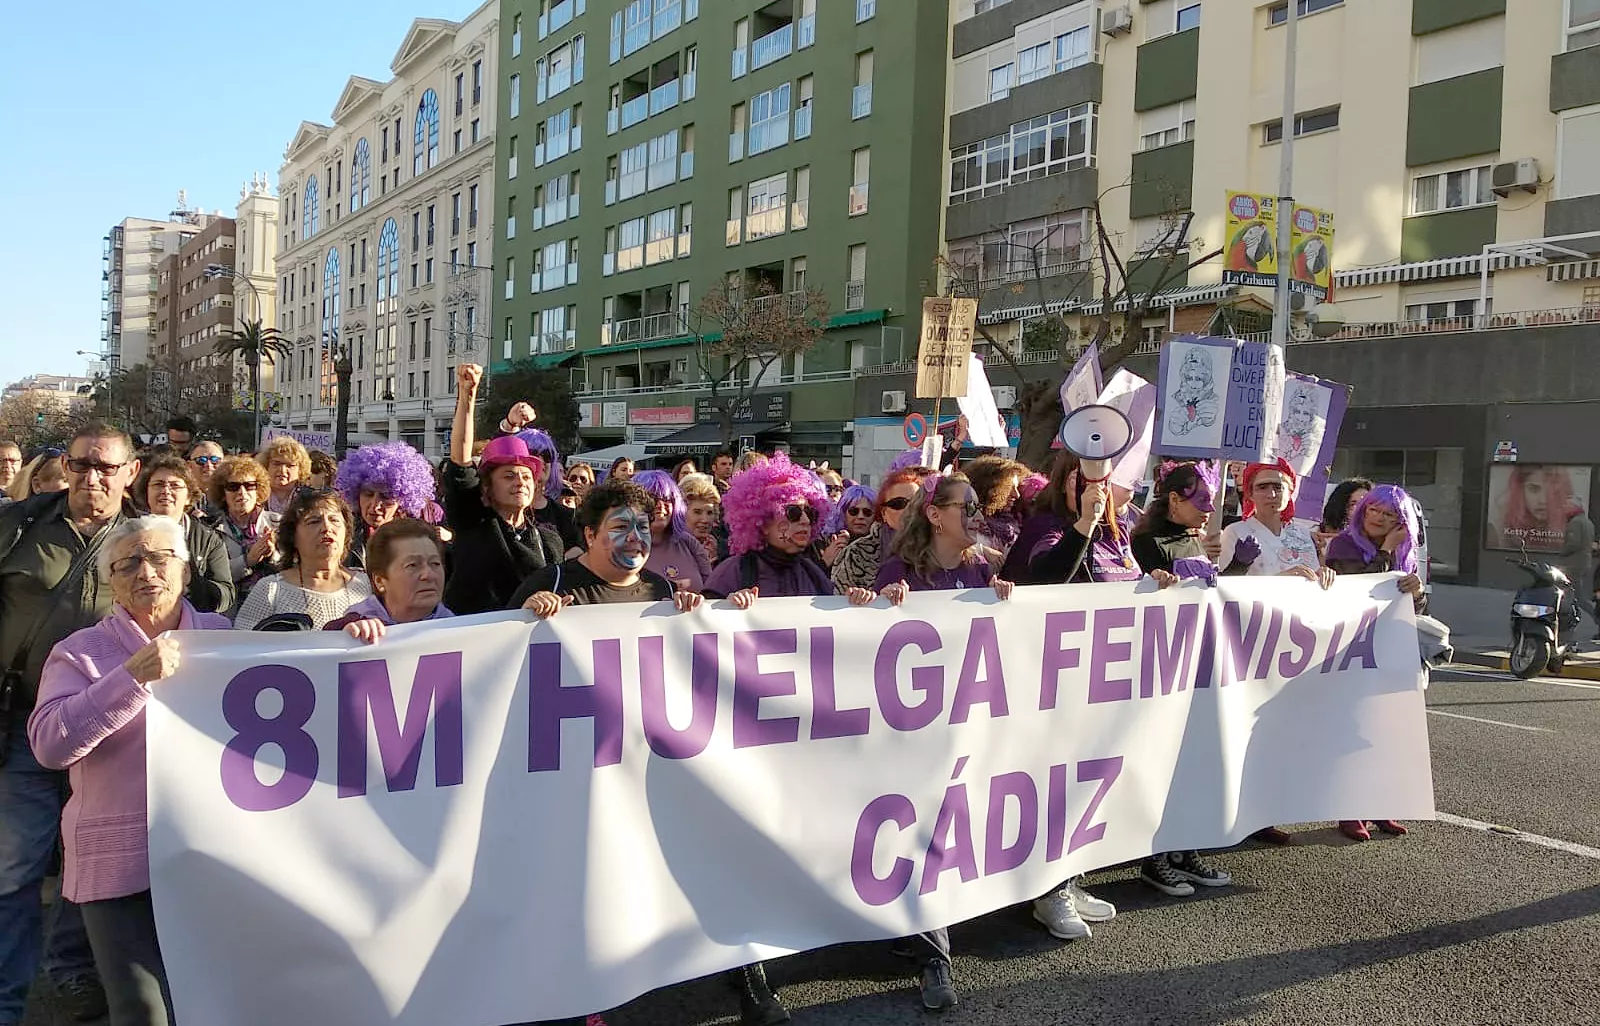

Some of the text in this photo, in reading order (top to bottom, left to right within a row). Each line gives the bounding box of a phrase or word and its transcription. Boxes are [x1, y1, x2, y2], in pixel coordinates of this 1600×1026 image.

[1227, 271, 1276, 286] La Cubana
[926, 325, 969, 342] OVARIOS
[1234, 347, 1270, 366] MUJE
[1232, 367, 1268, 384] DiVER
[1504, 527, 1528, 538] Ketty
[220, 602, 1378, 812] 8M HUELGA FEMINISTA
[851, 756, 1124, 906] CÁDIZ
